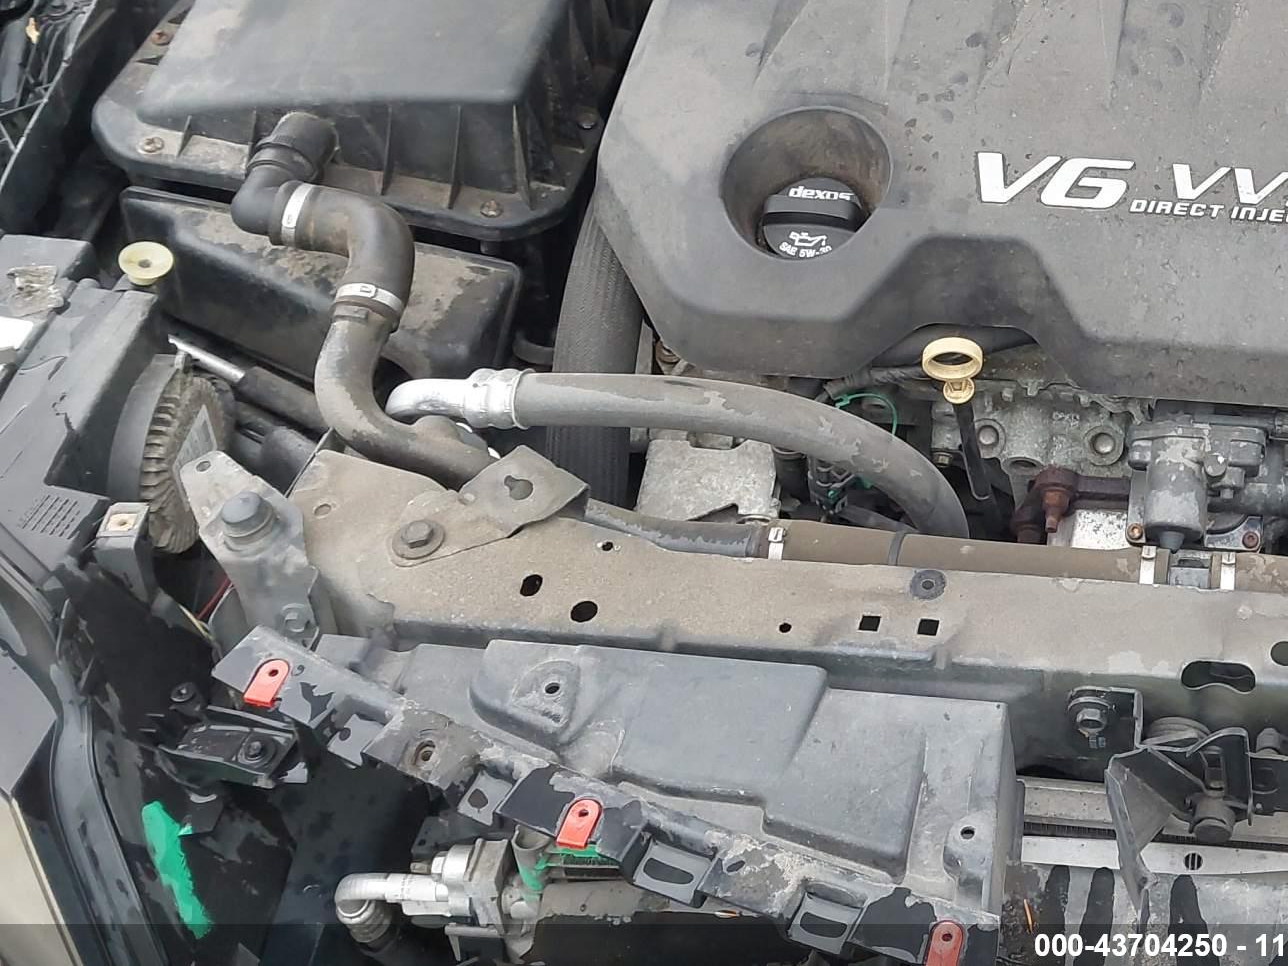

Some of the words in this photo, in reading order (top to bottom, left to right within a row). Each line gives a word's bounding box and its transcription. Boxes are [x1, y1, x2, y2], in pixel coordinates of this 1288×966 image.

[977, 151, 1135, 209] V6
[788, 185, 855, 201] dexos
[1129, 199, 1224, 218] DIRECT
[779, 241, 798, 256] SAE
